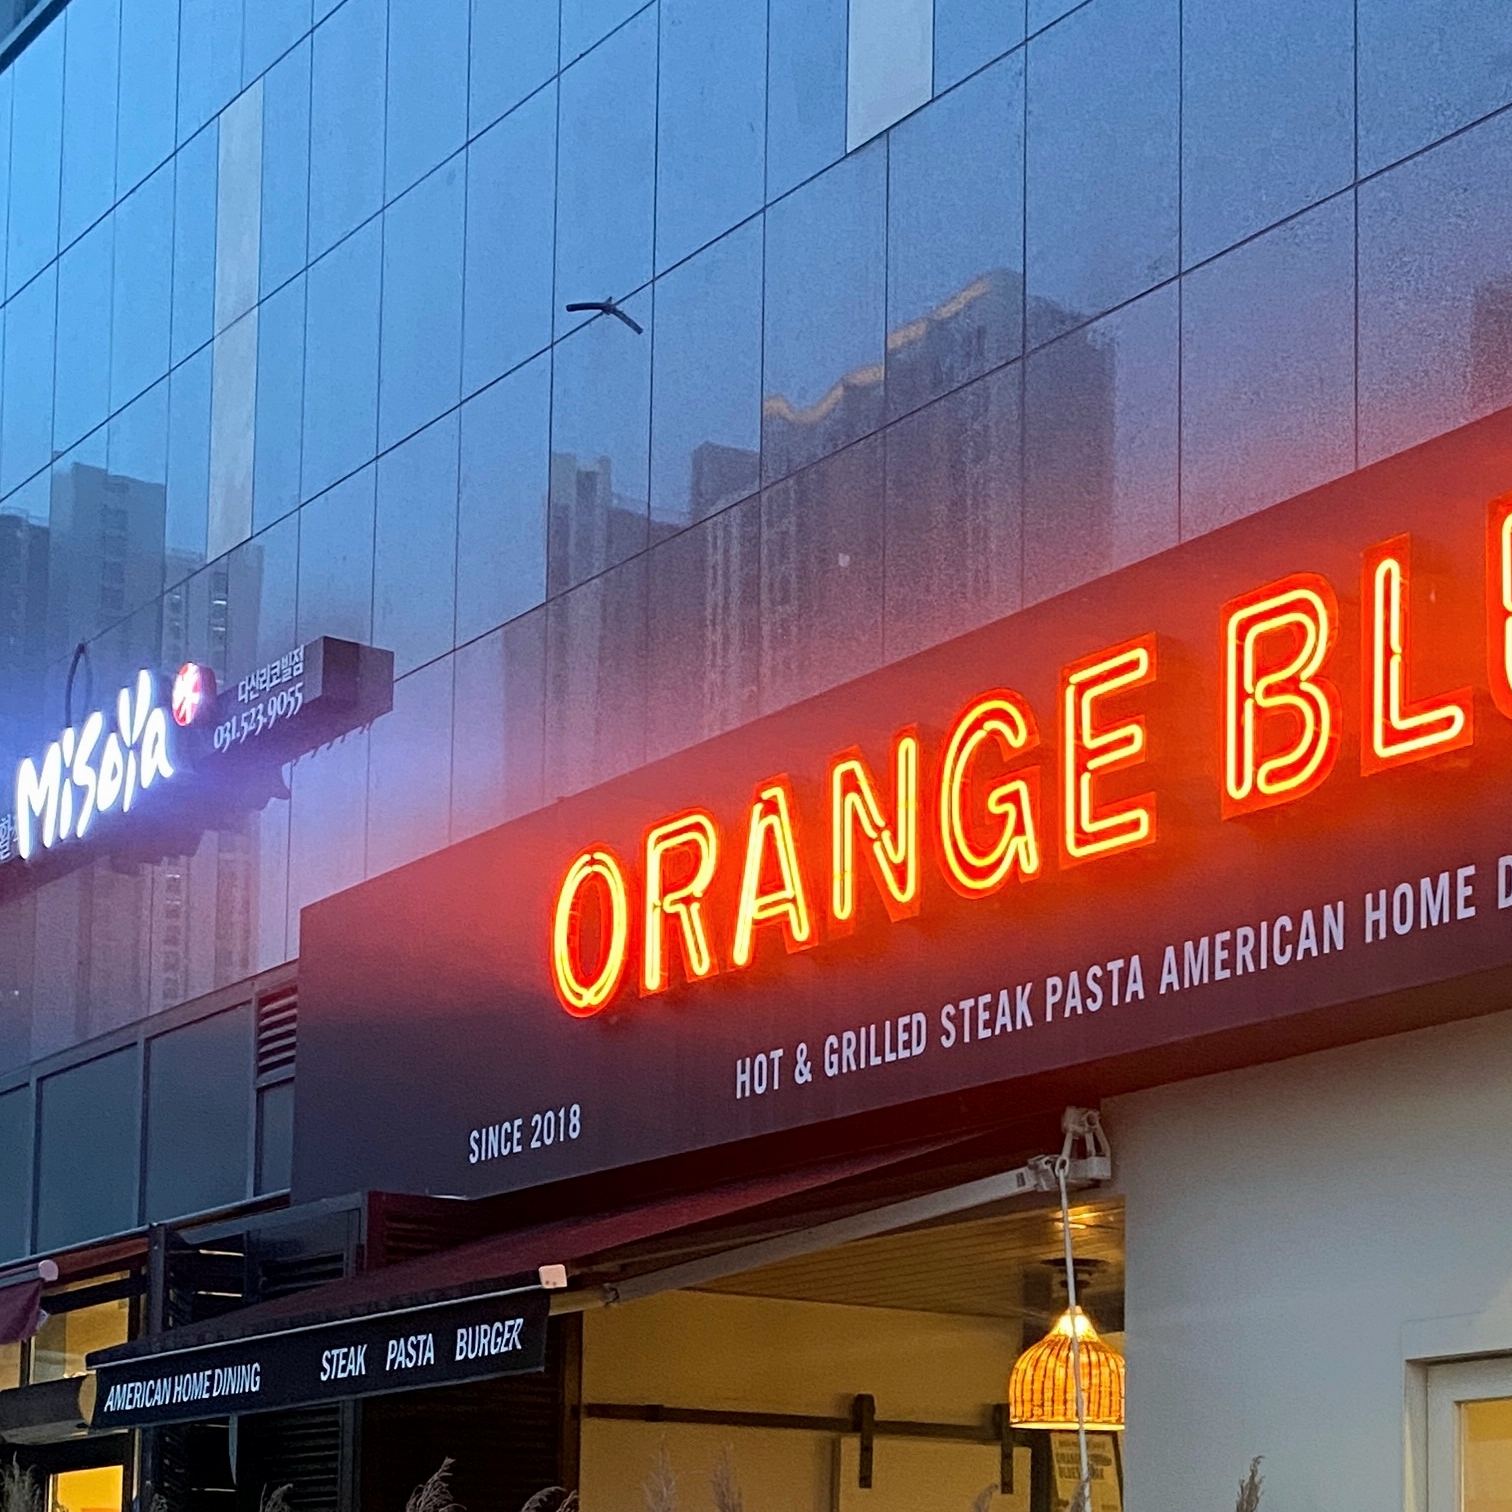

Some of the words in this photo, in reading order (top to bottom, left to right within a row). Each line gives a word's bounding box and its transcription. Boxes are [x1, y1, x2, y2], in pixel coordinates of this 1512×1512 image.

[238, 644, 305, 704] 다산리코빌점
[213, 682, 304, 753] 031.523.9055
[551, 635, 1156, 1016] ORANGE
[736, 1048, 783, 1099] HOT
[794, 1042, 812, 1084] &
[824, 1012, 927, 1077] GRILLED
[940, 982, 1033, 1049] STEAK
[1045, 954, 1145, 1022] PASTA
[1159, 901, 1345, 995] AMERICAN
[1364, 864, 1476, 943] HOME
[469, 1118, 522, 1164] SINCE
[530, 1103, 580, 1148] 2018
[103, 1377, 172, 1412] AMERICAN
[172, 1369, 213, 1404] HOME
[212, 1362, 261, 1397] DINING
[320, 1343, 368, 1381] STEAK
[385, 1333, 435, 1371] PASTA
[455, 1318, 524, 1361] BURGER
